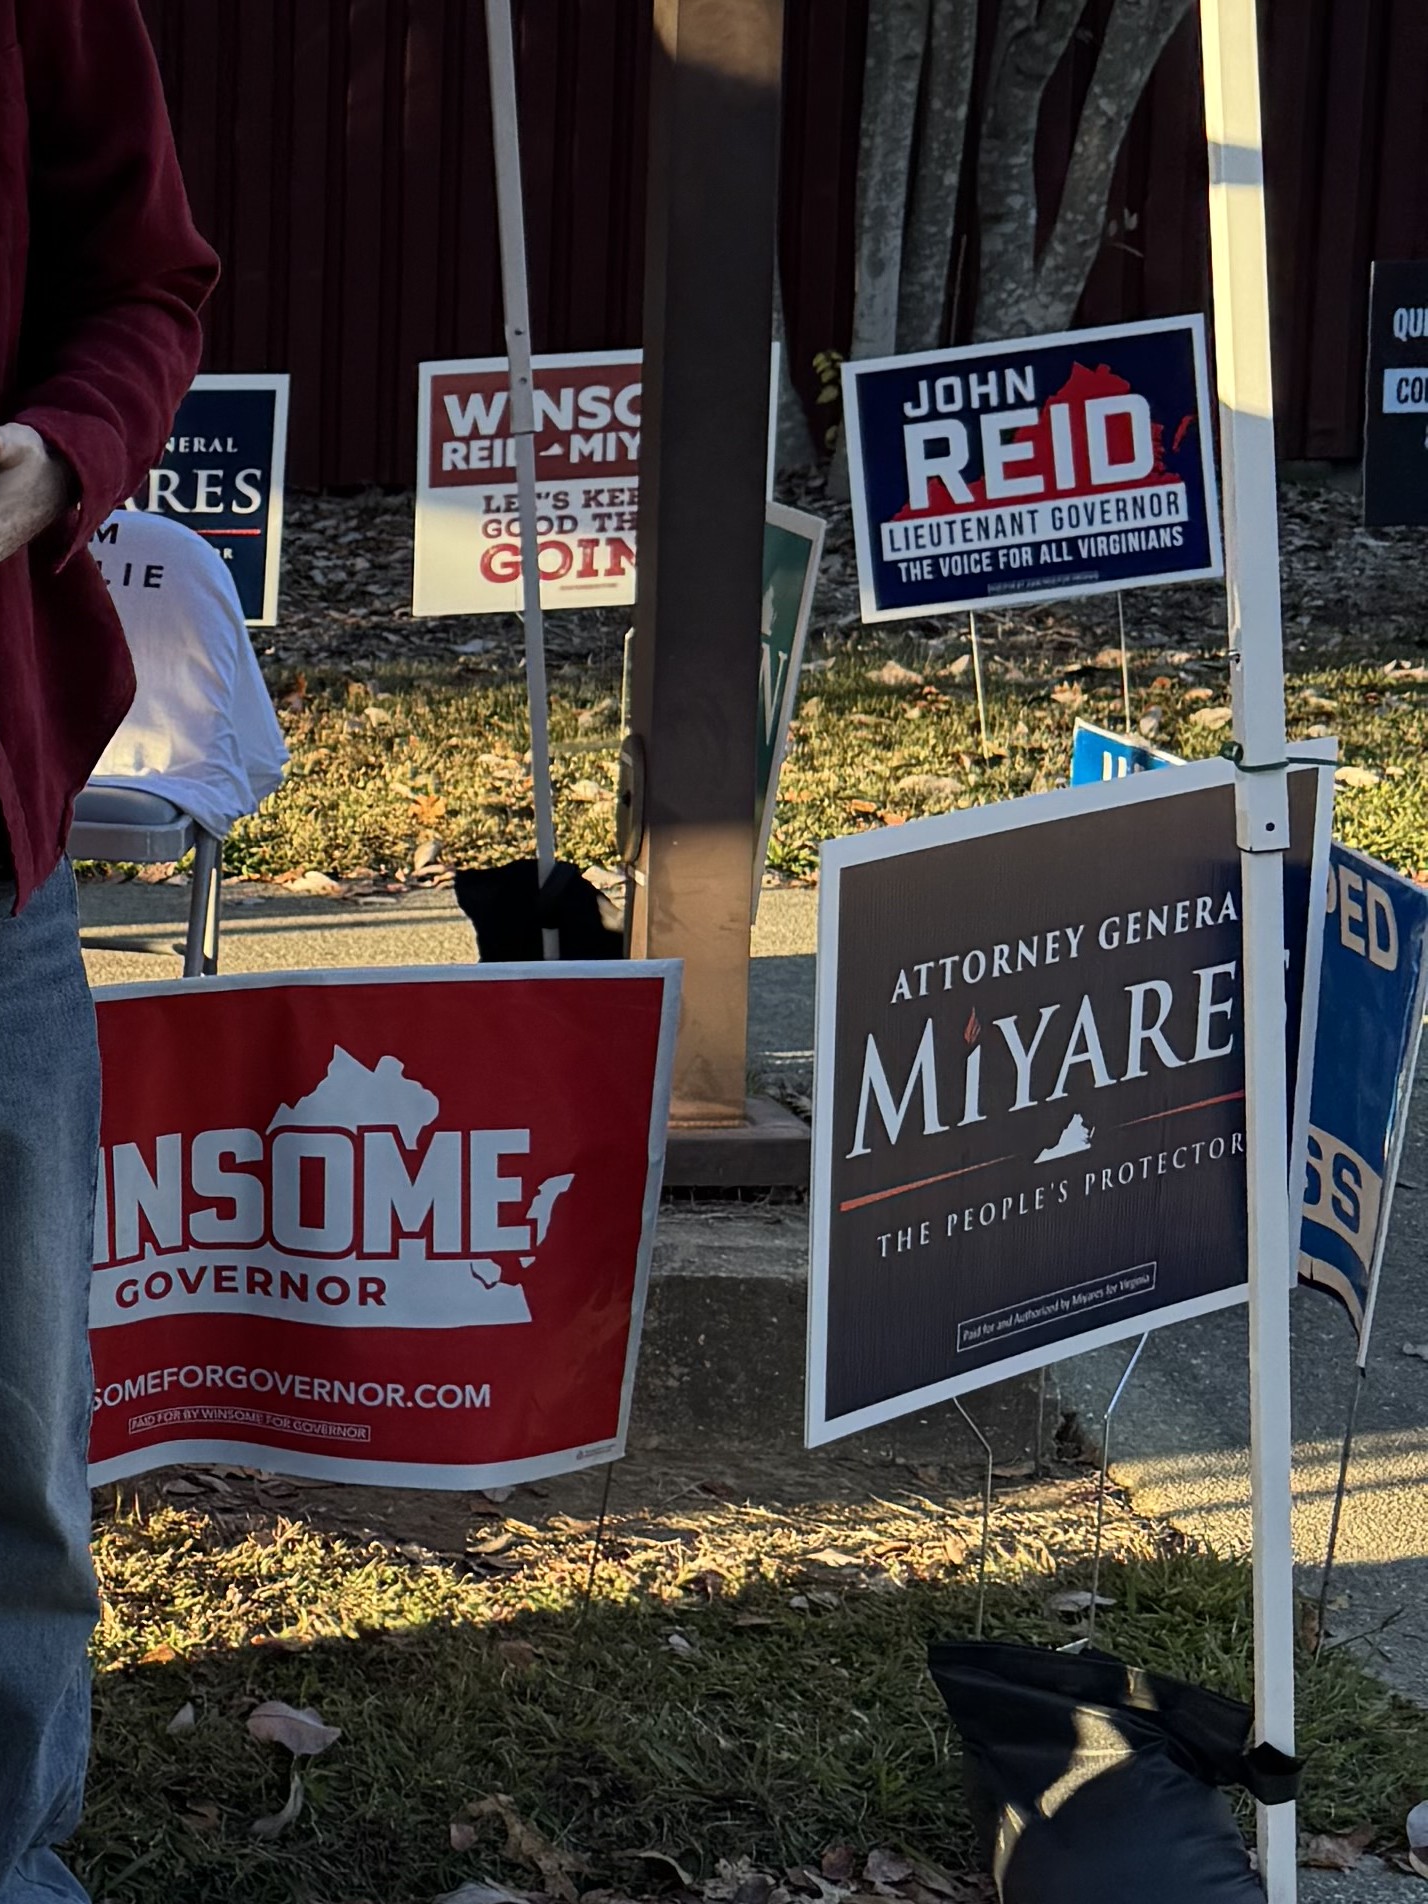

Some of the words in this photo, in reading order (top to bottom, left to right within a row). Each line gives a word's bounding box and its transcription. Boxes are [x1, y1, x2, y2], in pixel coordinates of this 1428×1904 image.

[903, 365, 1036, 418] JOHN
[903, 393, 1156, 511] REID
[889, 509, 1040, 553] LIEUTENANT
[1051, 491, 1181, 532] GOVERNOR
[897, 558, 934, 584] THE
[939, 550, 993, 578] VOICE
[998, 544, 1033, 570] FOR
[1039, 540, 1073, 566] ALL
[1078, 526, 1184, 560] VIRGINIANS
[890, 924, 1085, 1005] ATTORNEY
[1097, 891, 1239, 951] GENERA
[92, 1128, 531, 1264] NSOME
[877, 1221, 931, 1257] THE
[947, 1180, 1069, 1237] PEOPLE'S
[1084, 1131, 1245, 1196] PROTECTOR
[114, 1264, 387, 1309] GOVERNOR
[94, 1364, 492, 1412] OMEFORGOVERNOR.COM
